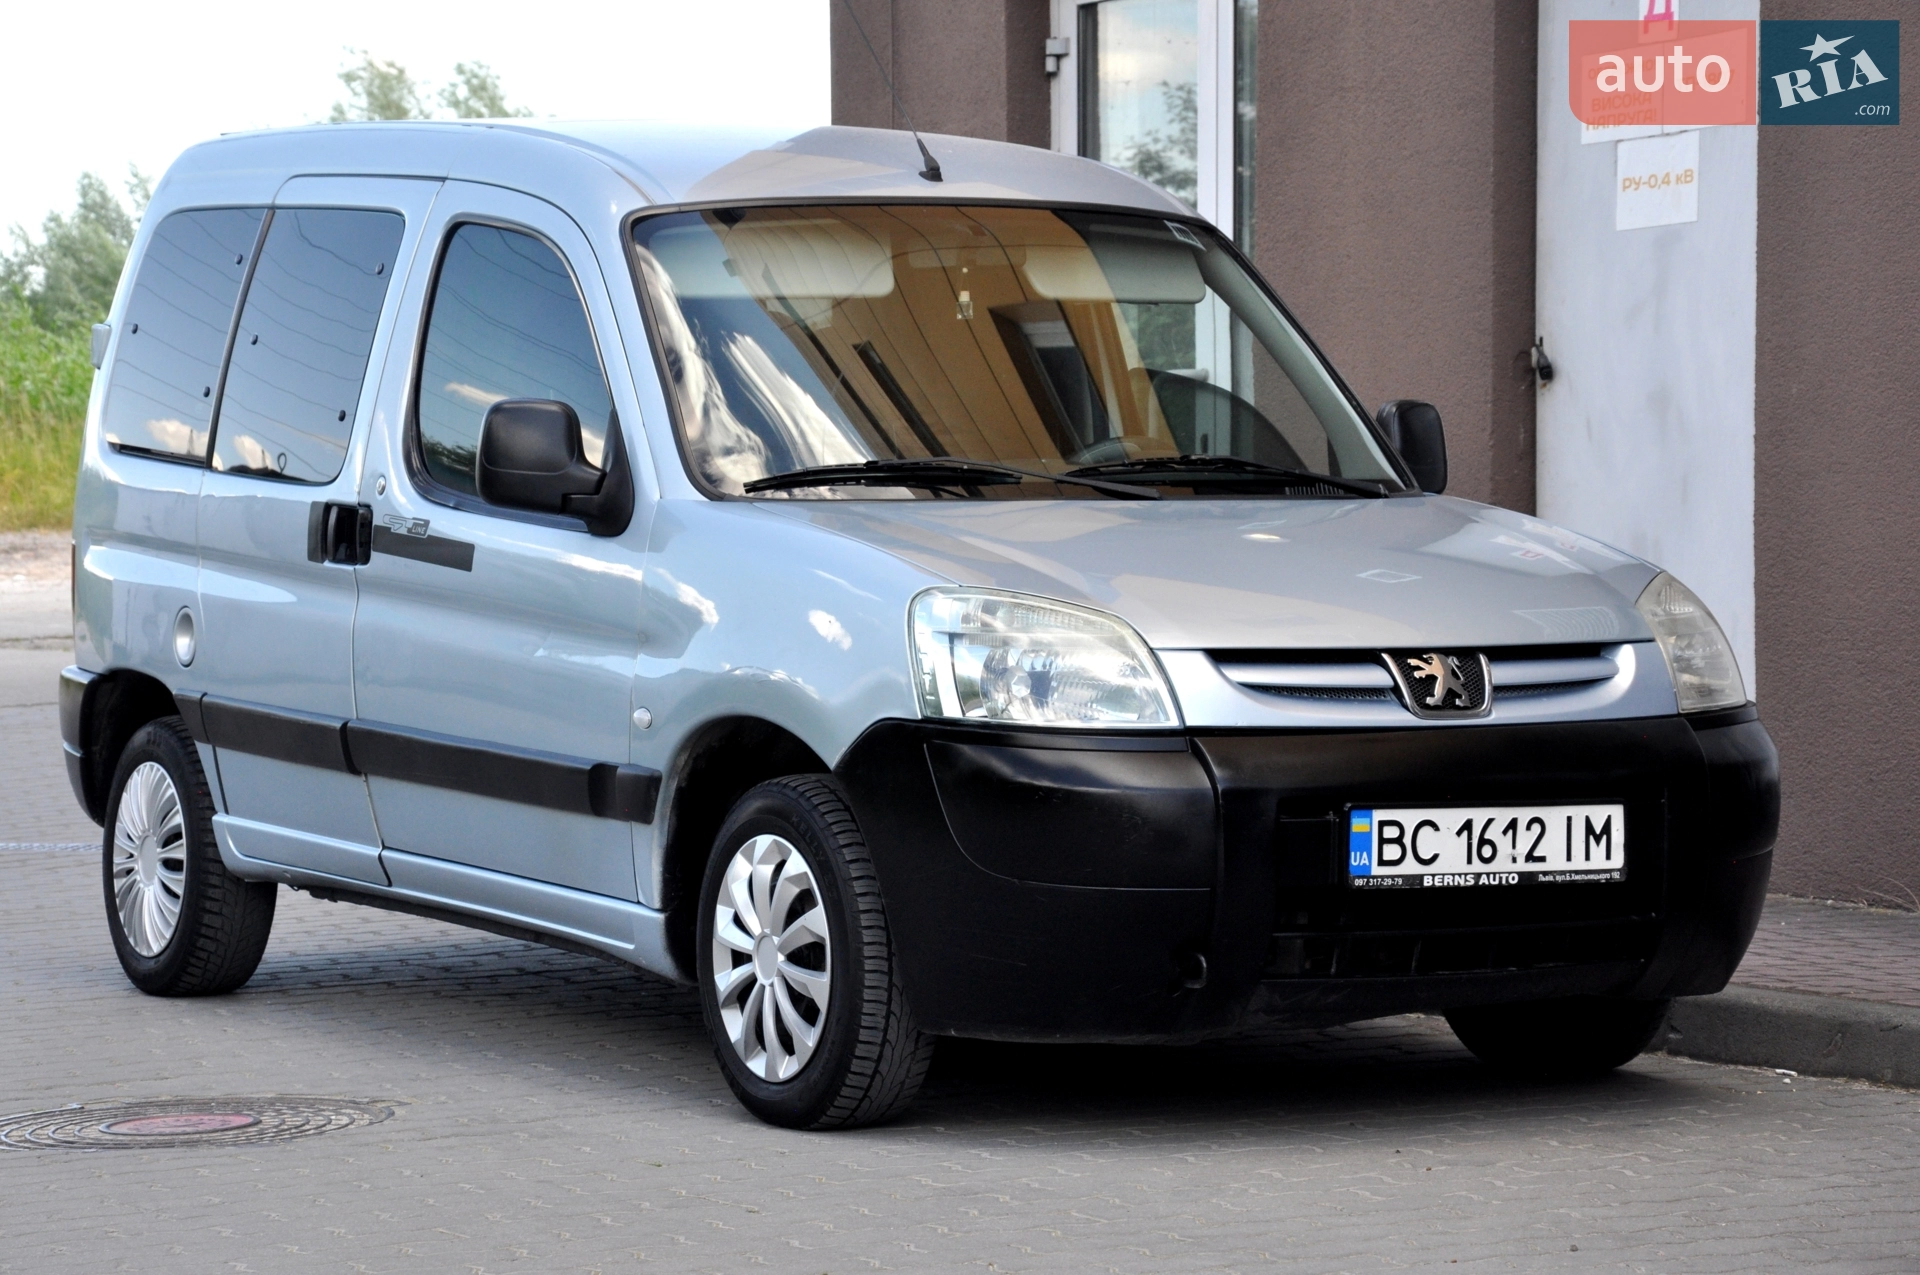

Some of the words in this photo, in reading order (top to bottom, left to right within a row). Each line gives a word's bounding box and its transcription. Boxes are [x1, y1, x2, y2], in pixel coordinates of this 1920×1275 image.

[1591, 91, 1652, 113] ВИСОКА
[1586, 108, 1657, 132] НАПРУГА!
[411, 525, 427, 534] LINE
[1377, 819, 1440, 866] BC
[1455, 816, 1546, 865] 1612
[1566, 814, 1613, 862] IM
[1350, 851, 1370, 866] UA
[1423, 874, 1475, 887] BERNS
[1479, 873, 1518, 885] AUTO
